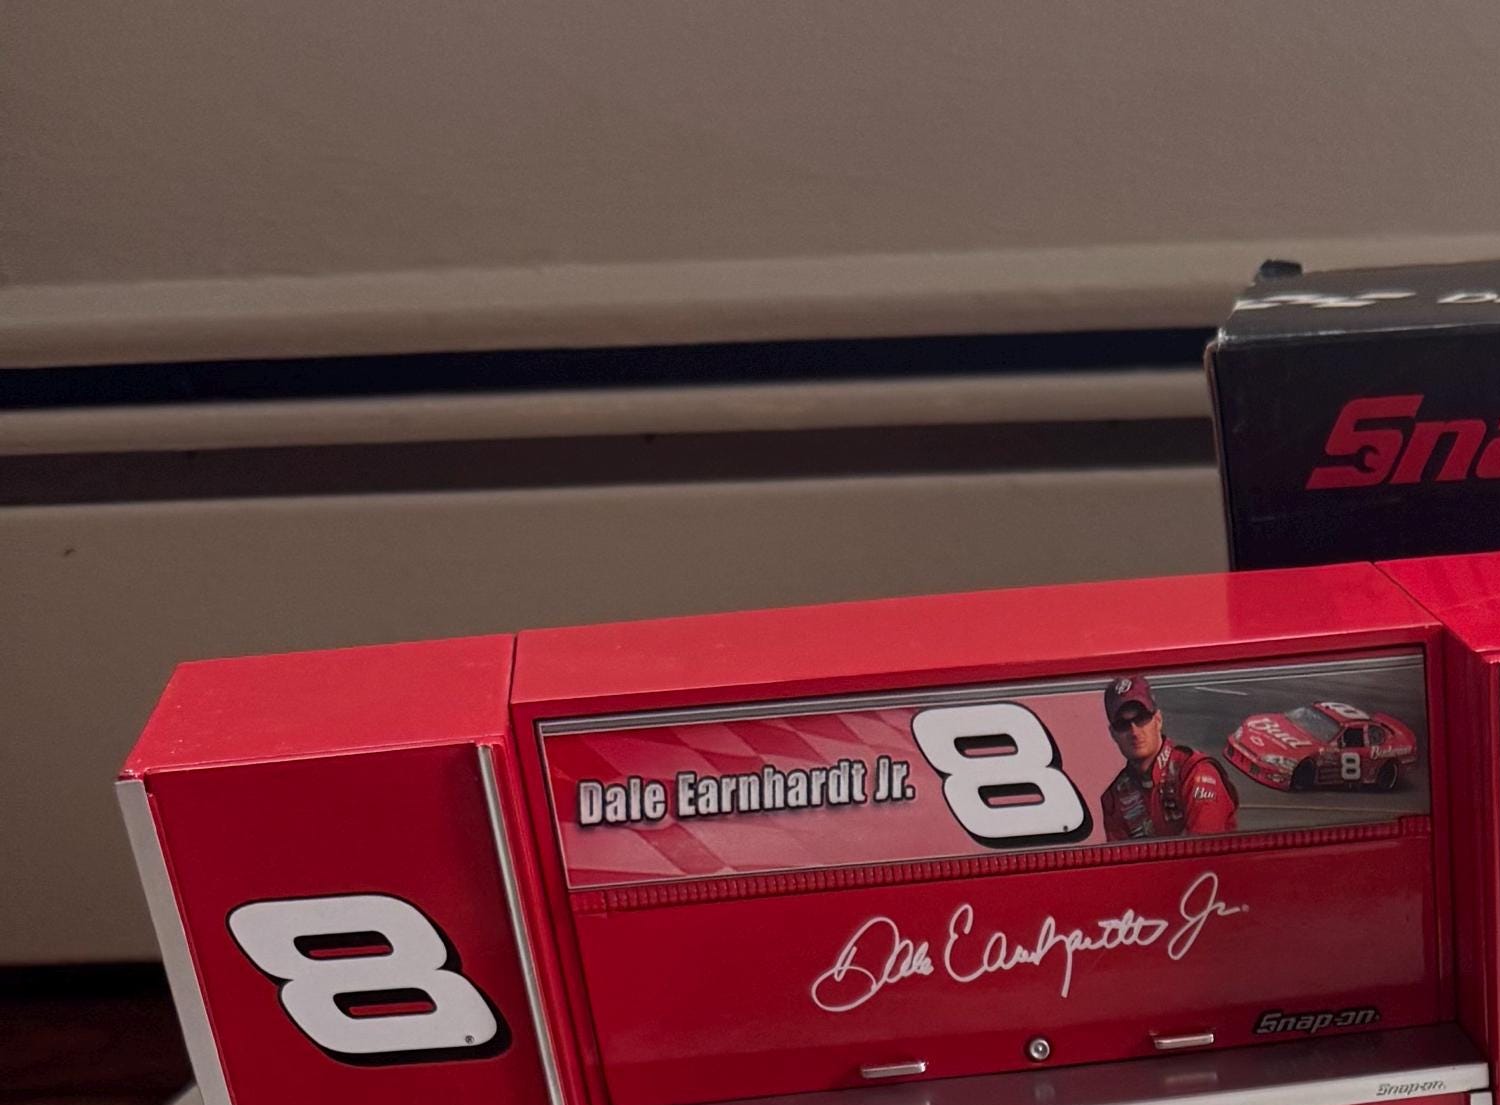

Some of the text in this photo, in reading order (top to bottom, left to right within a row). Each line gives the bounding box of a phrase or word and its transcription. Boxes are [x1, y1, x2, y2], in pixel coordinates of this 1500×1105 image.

[1248, 717, 1312, 749] Bud
[911, 701, 1094, 849] 8
[1340, 752, 1361, 780] 8
[578, 754, 916, 828] Dale Earnhardt Jr.
[225, 891, 511, 1068] 8
[1256, 1008, 1380, 1035] Snap-on
[1376, 1079, 1446, 1097] Snap-on
